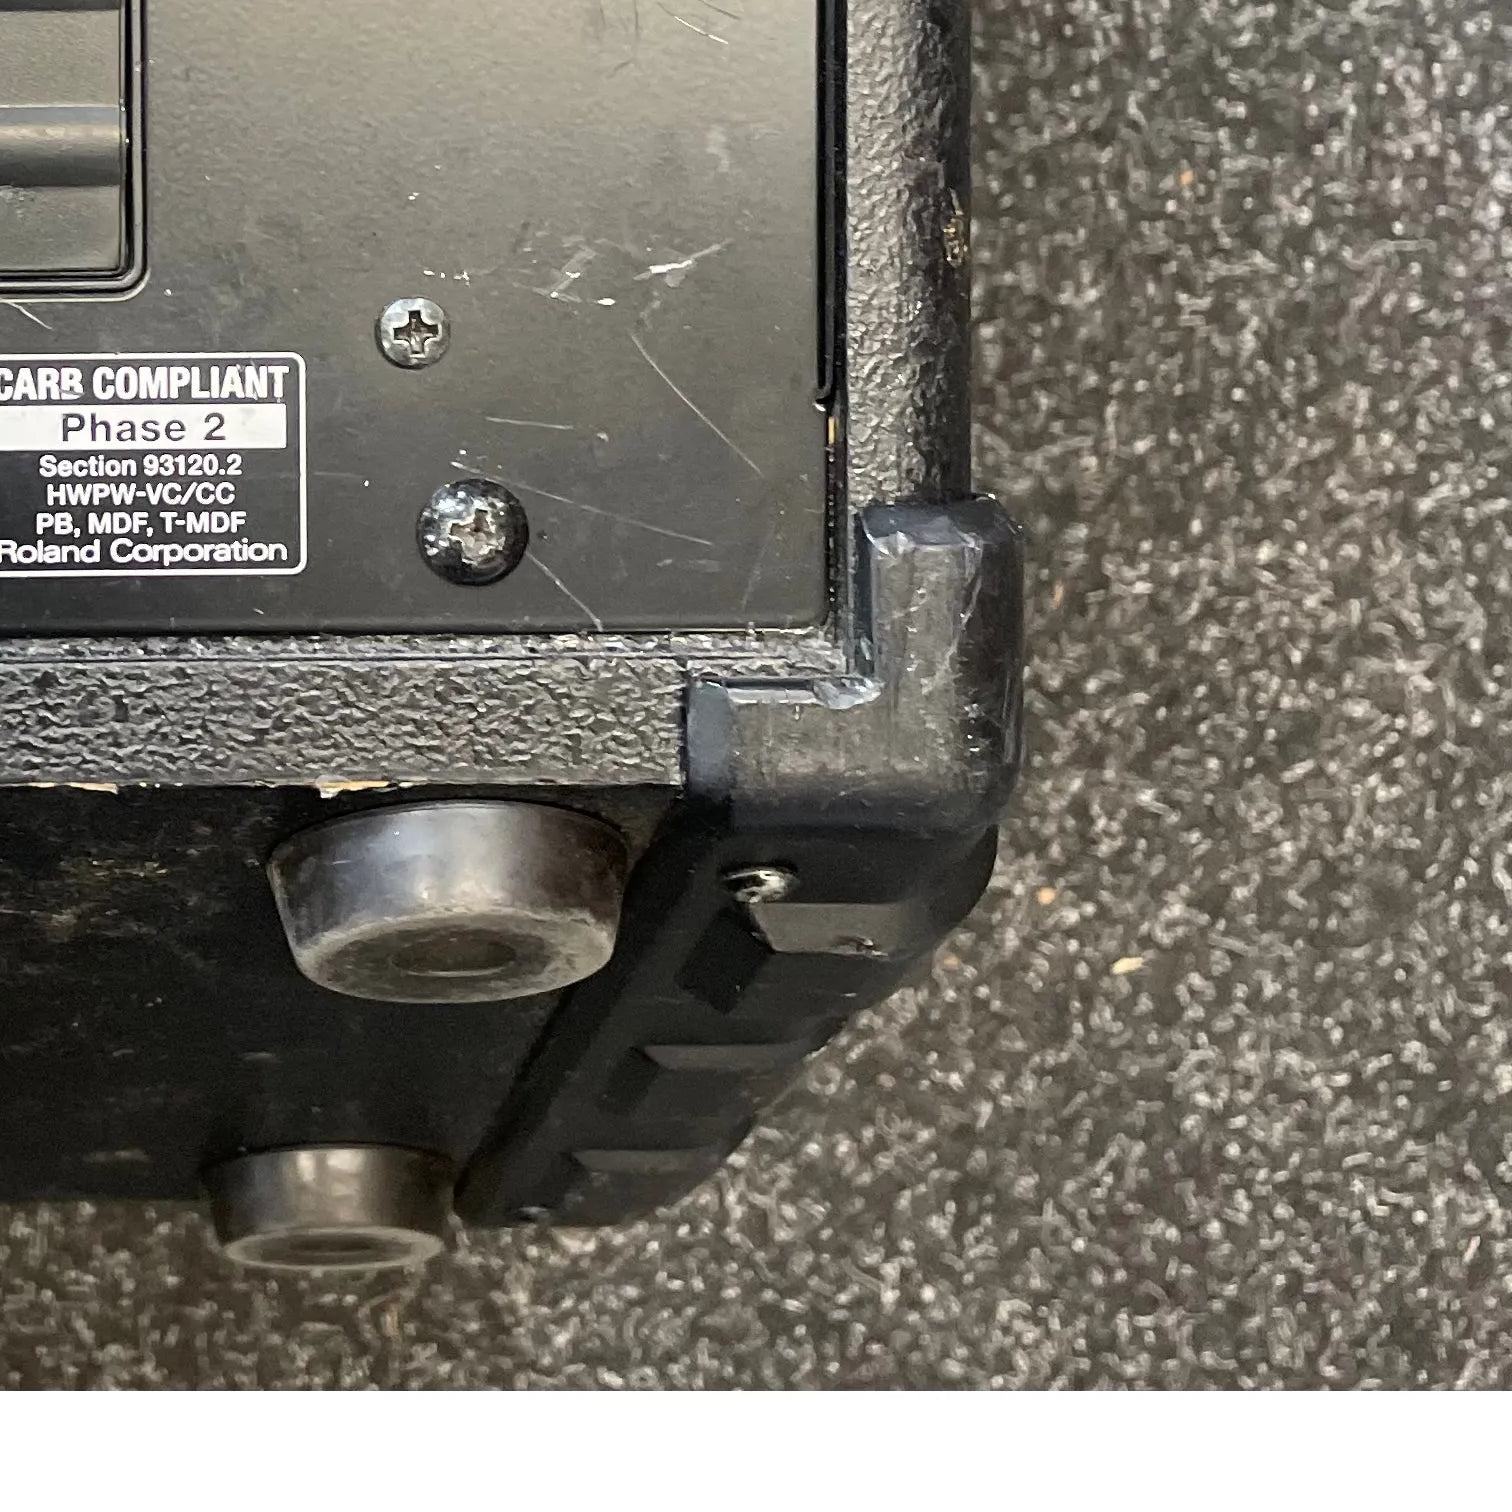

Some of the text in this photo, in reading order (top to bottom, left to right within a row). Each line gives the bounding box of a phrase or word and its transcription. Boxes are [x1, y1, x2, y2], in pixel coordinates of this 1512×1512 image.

[93, 365, 289, 400] COMPLIANT
[61, 412, 227, 443] Phase 2
[39, 453, 243, 477] Section 93120.2
[46, 482, 236, 506] HWPW-VC/CC
[36, 511, 247, 538] PB, MDF, T-MDF
[110, 538, 288, 566] Corporation
